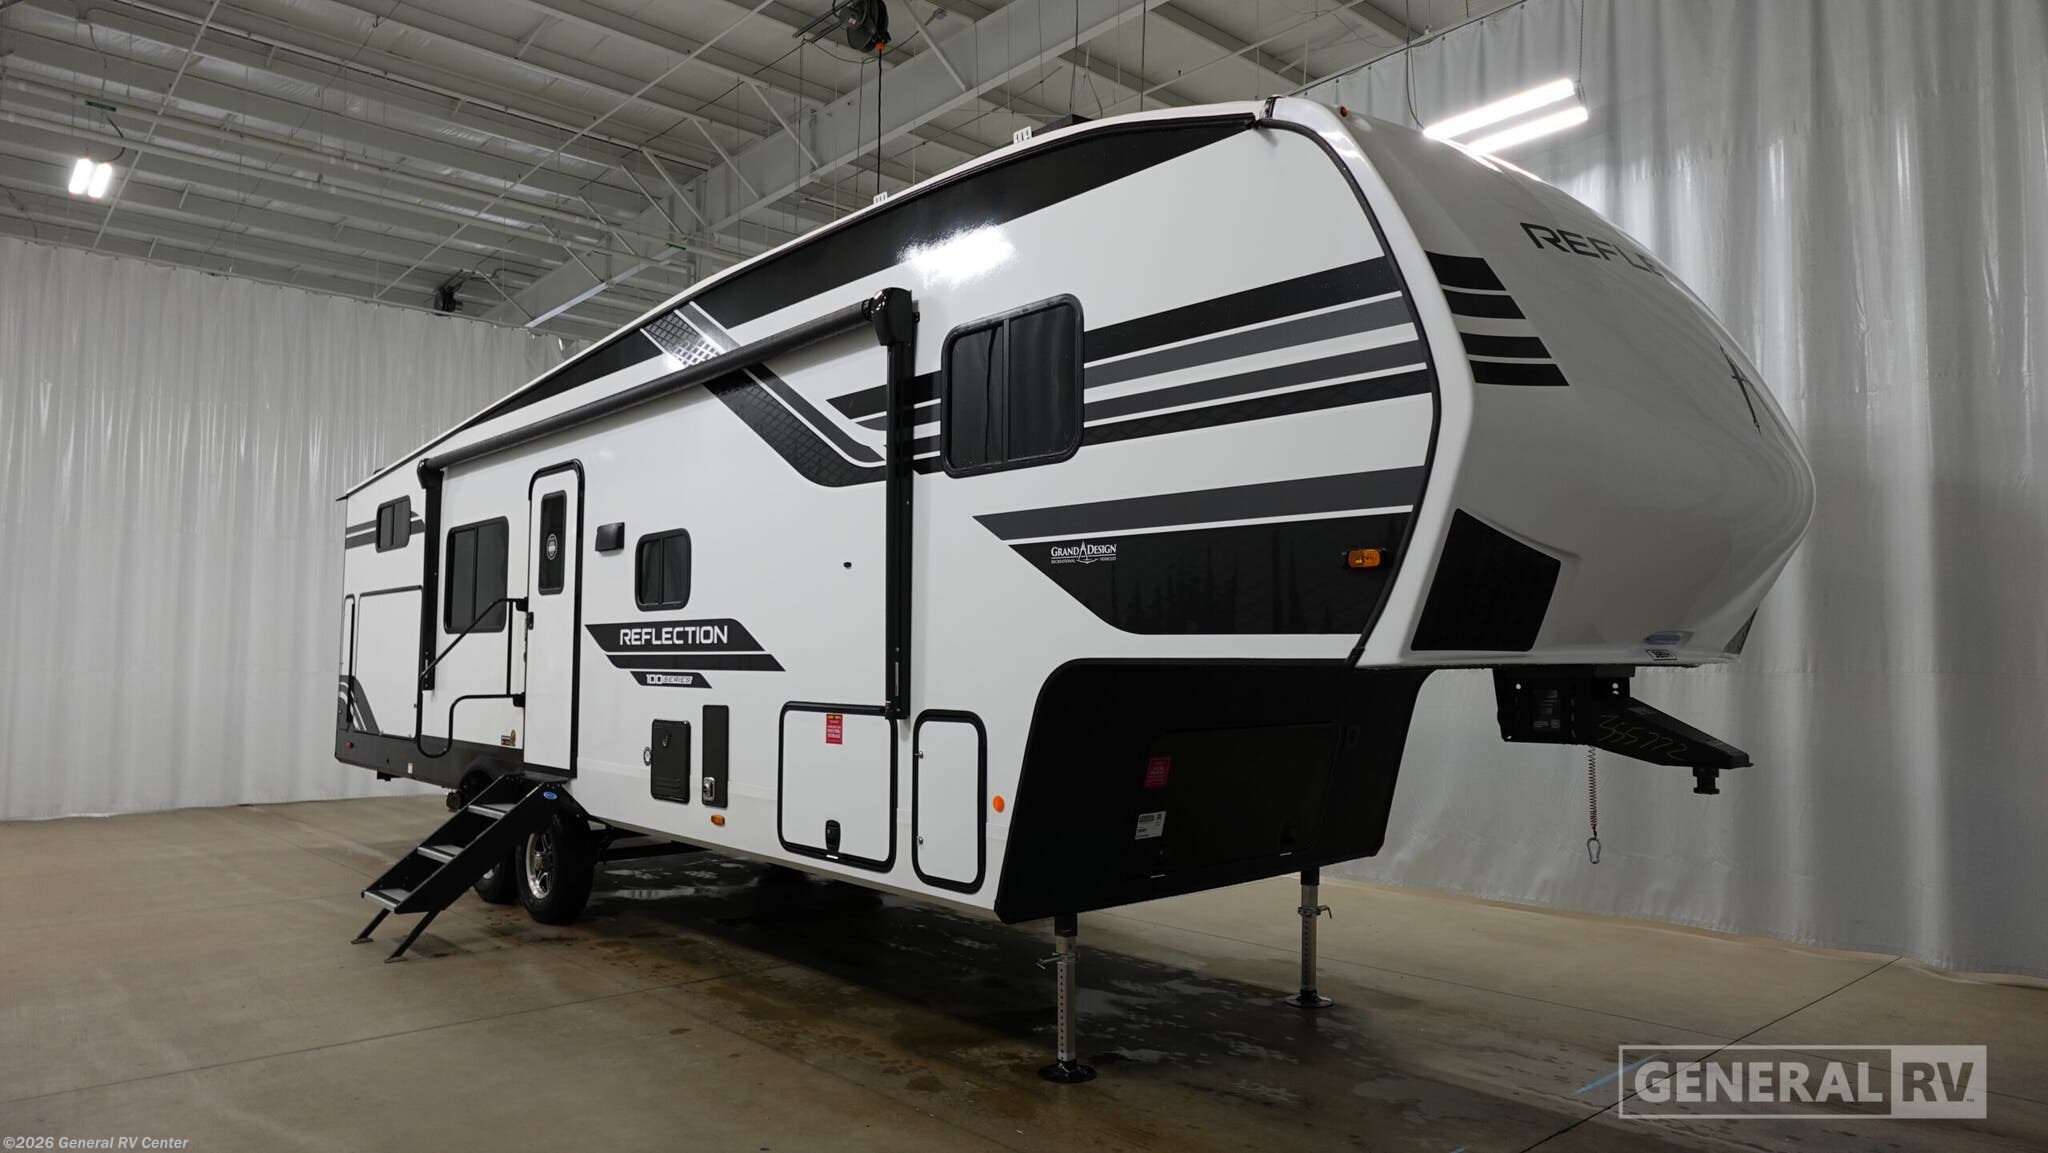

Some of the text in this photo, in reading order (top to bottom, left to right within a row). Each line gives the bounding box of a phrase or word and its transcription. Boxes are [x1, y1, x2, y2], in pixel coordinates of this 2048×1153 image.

[1050, 544, 1117, 557] GRAND DESIGN
[620, 625, 728, 645] REFLECTION
